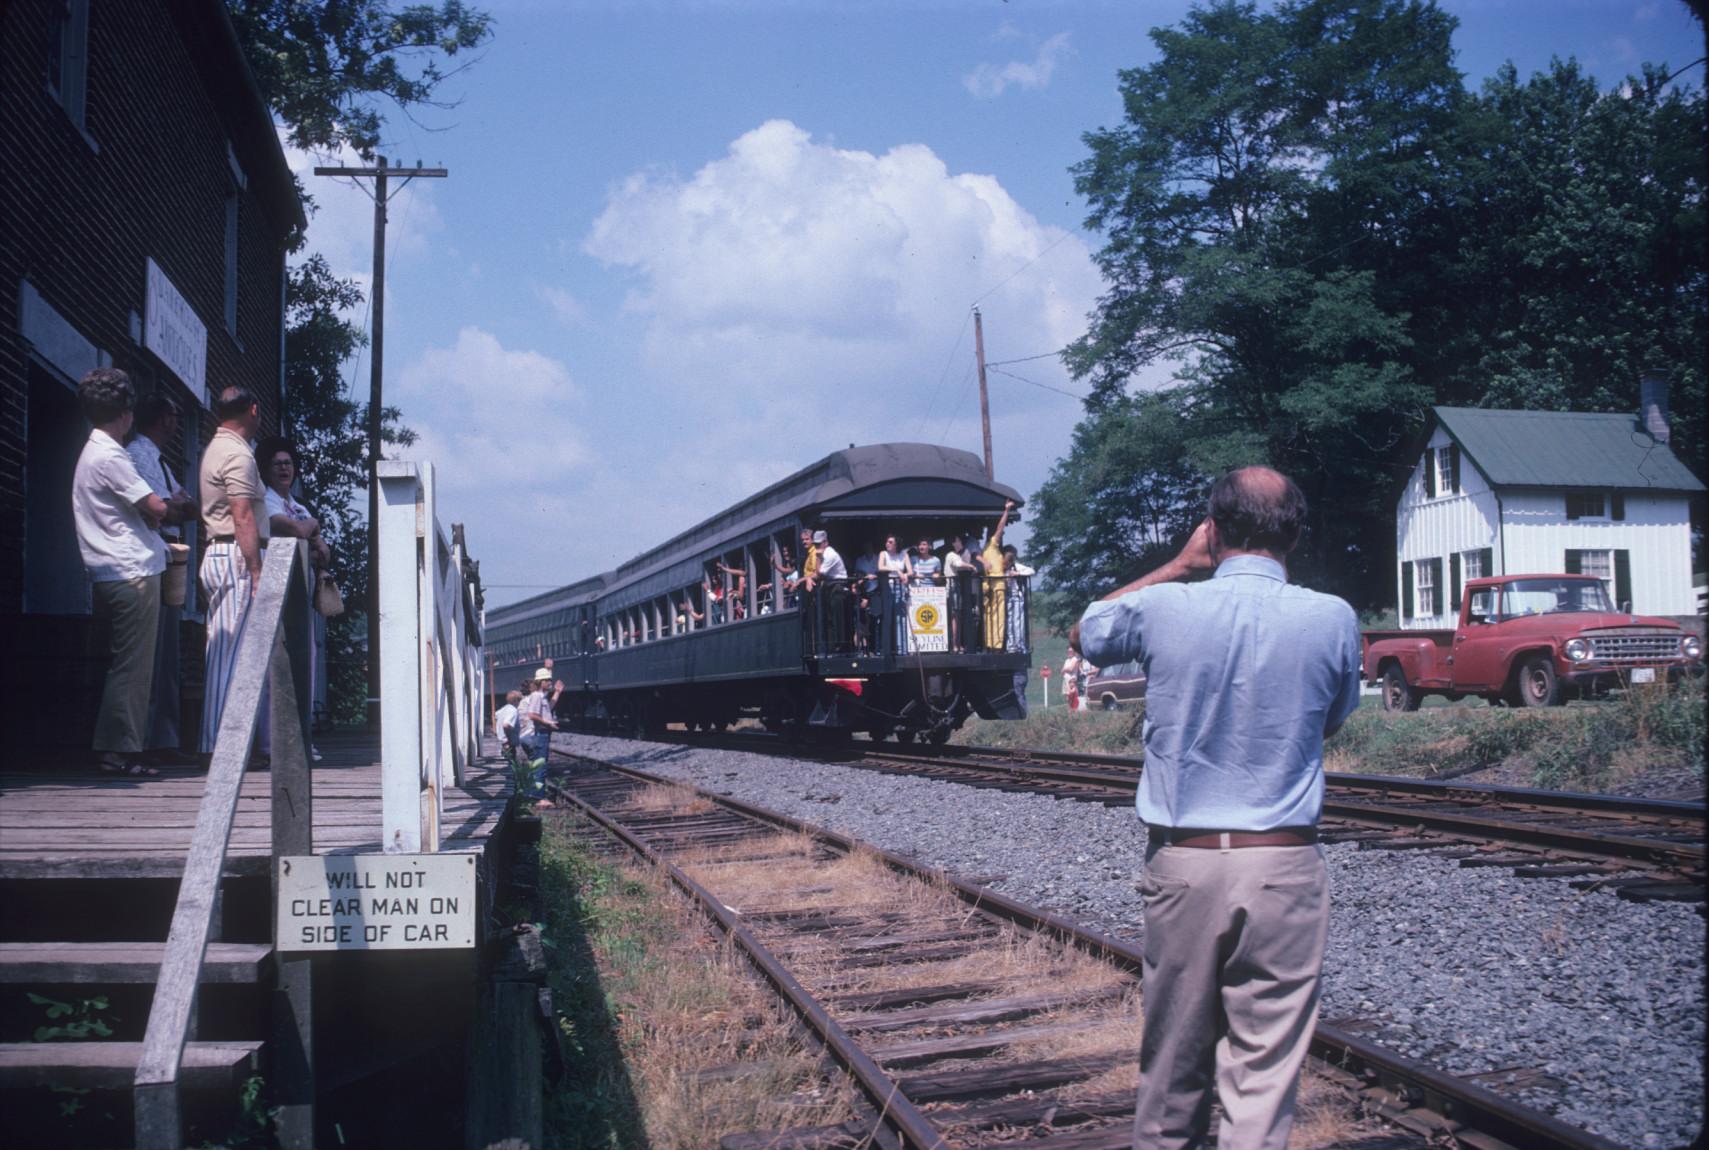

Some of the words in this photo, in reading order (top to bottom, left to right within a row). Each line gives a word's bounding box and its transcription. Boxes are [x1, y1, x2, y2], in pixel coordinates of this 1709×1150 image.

[909, 643, 948, 651] LMITED
[326, 871, 376, 889] WILL
[386, 871, 426, 889] NOT
[291, 899, 362, 917] CLEAR
[372, 898, 419, 915] MAN
[430, 897, 459, 914] ON
[301, 925, 353, 943] SIDE
[364, 924, 392, 942] OF
[404, 924, 449, 942] CAR
